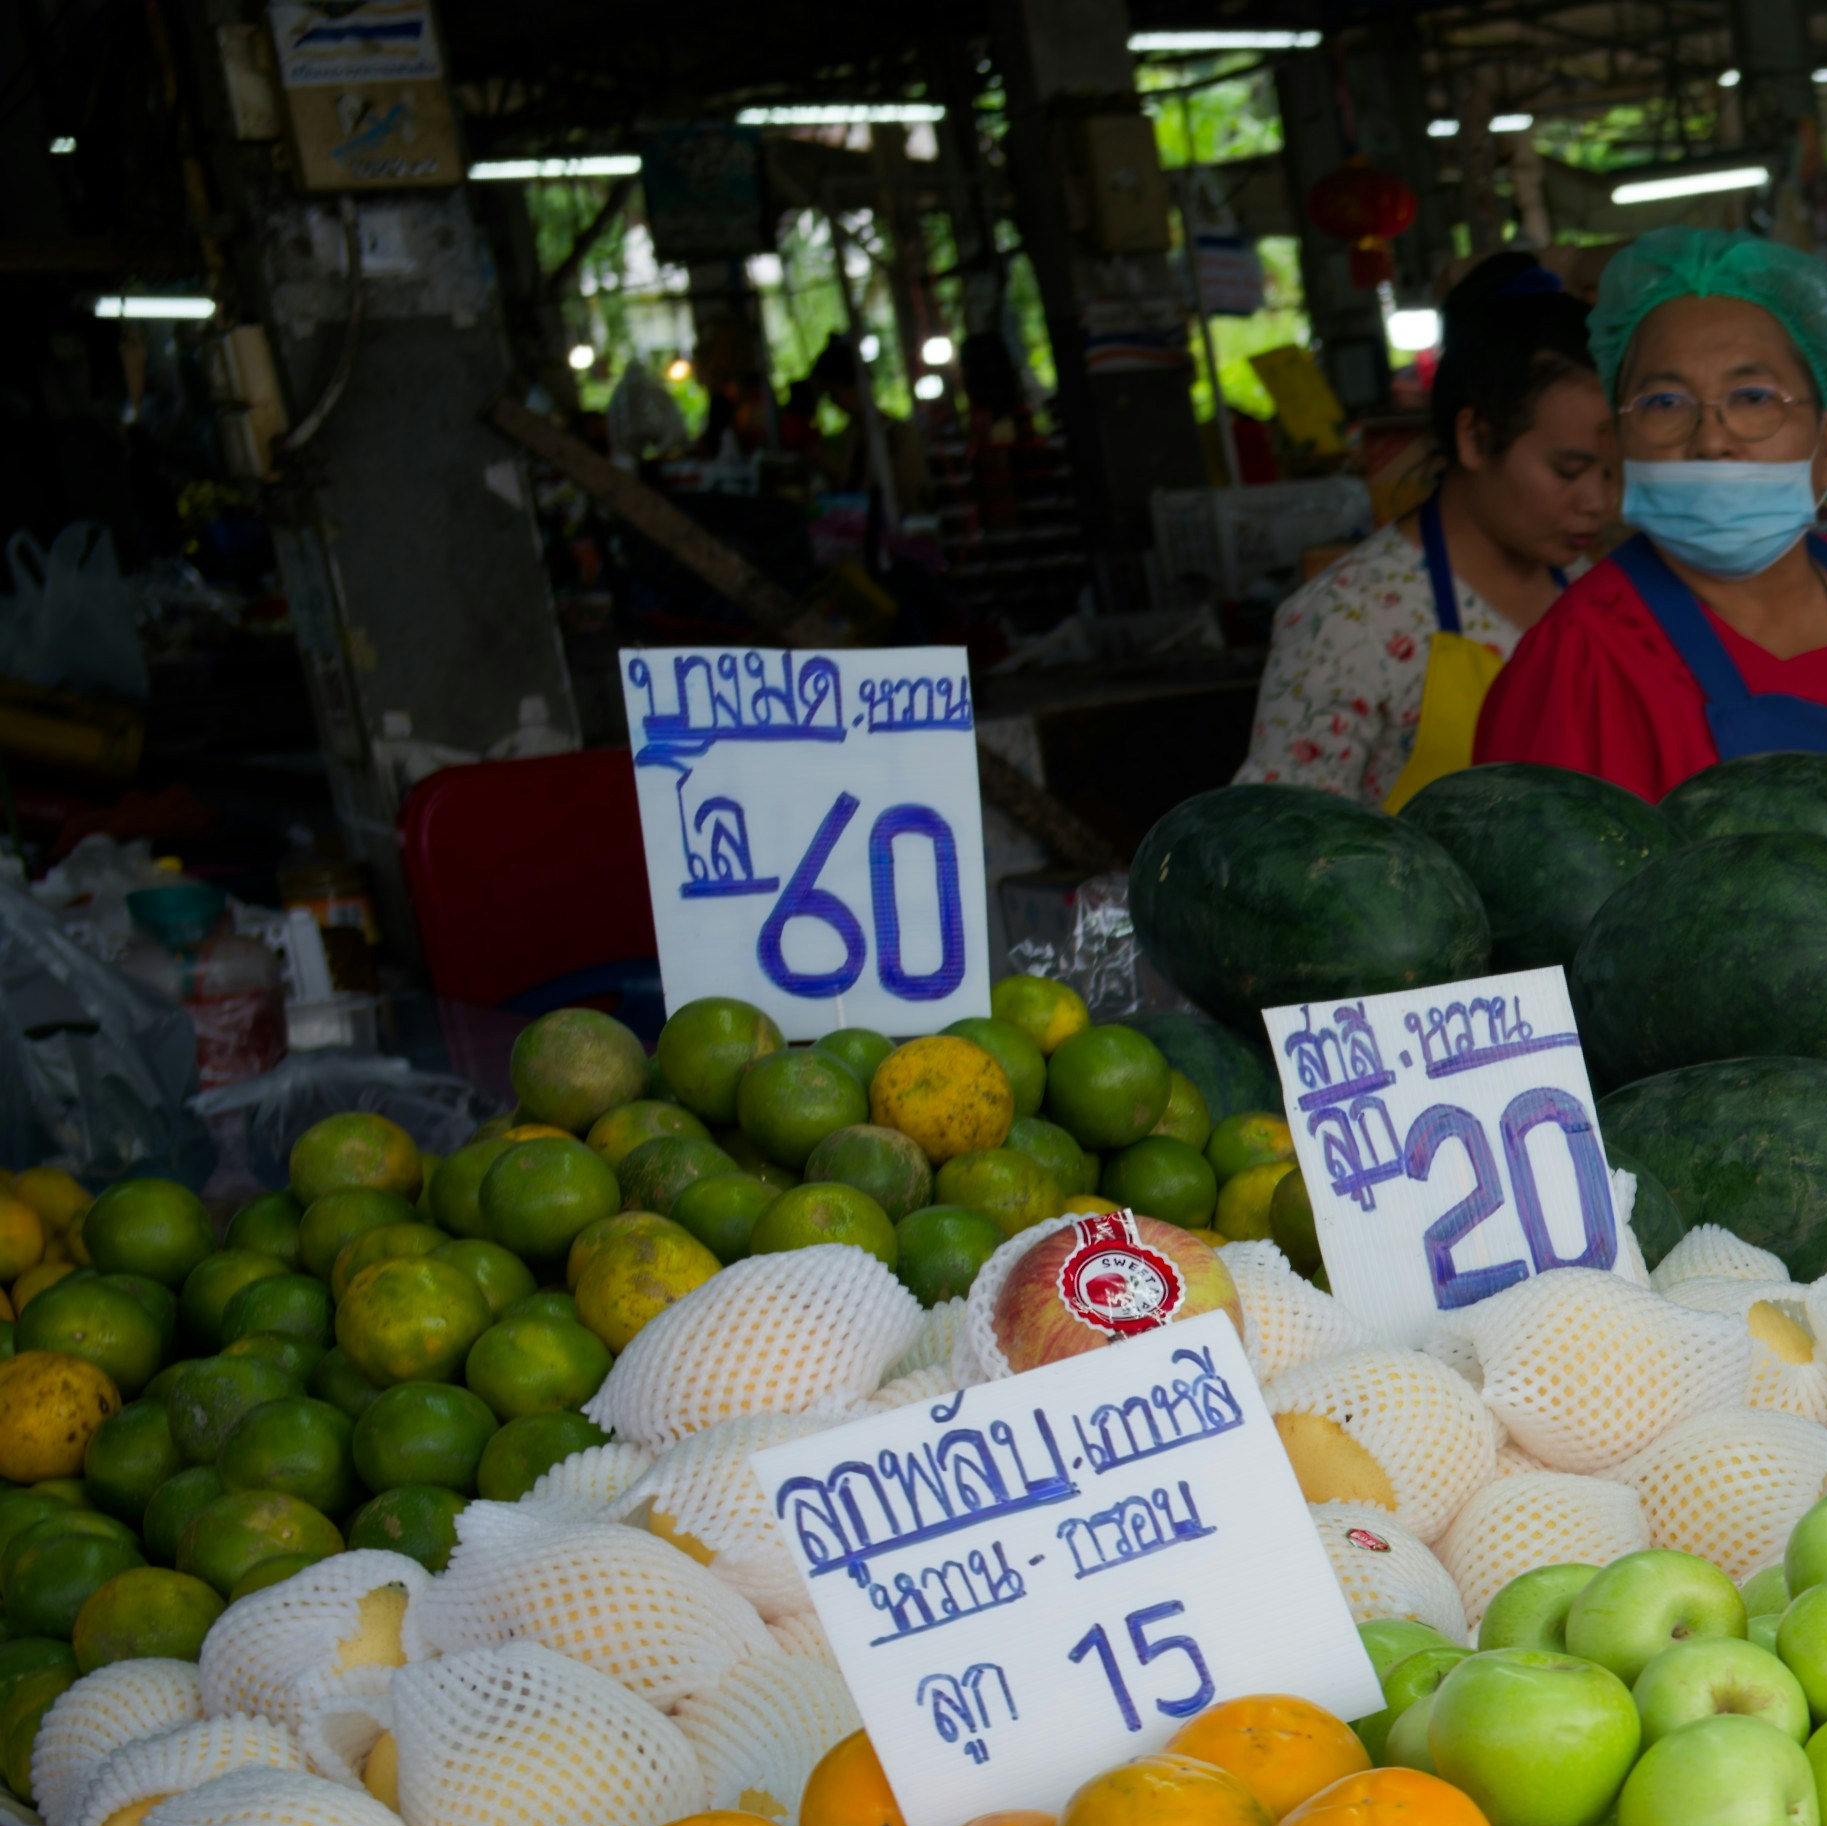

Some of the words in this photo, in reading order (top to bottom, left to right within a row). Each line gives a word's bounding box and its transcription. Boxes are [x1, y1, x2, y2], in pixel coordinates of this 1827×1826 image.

[859, 676, 974, 728] หวาน
[634, 740, 756, 881] โล
[757, 791, 966, 1002] 60
[1404, 996, 1533, 1072] หวาน
[1307, 1094, 1405, 1212] ลูก
[1404, 1087, 1619, 1310] 20
[869, 1541, 1026, 1632] หวาน
[1056, 1481, 1216, 1572] กรอบ
[917, 1663, 1019, 1764] ลูก
[1067, 1599, 1216, 1733] 15
